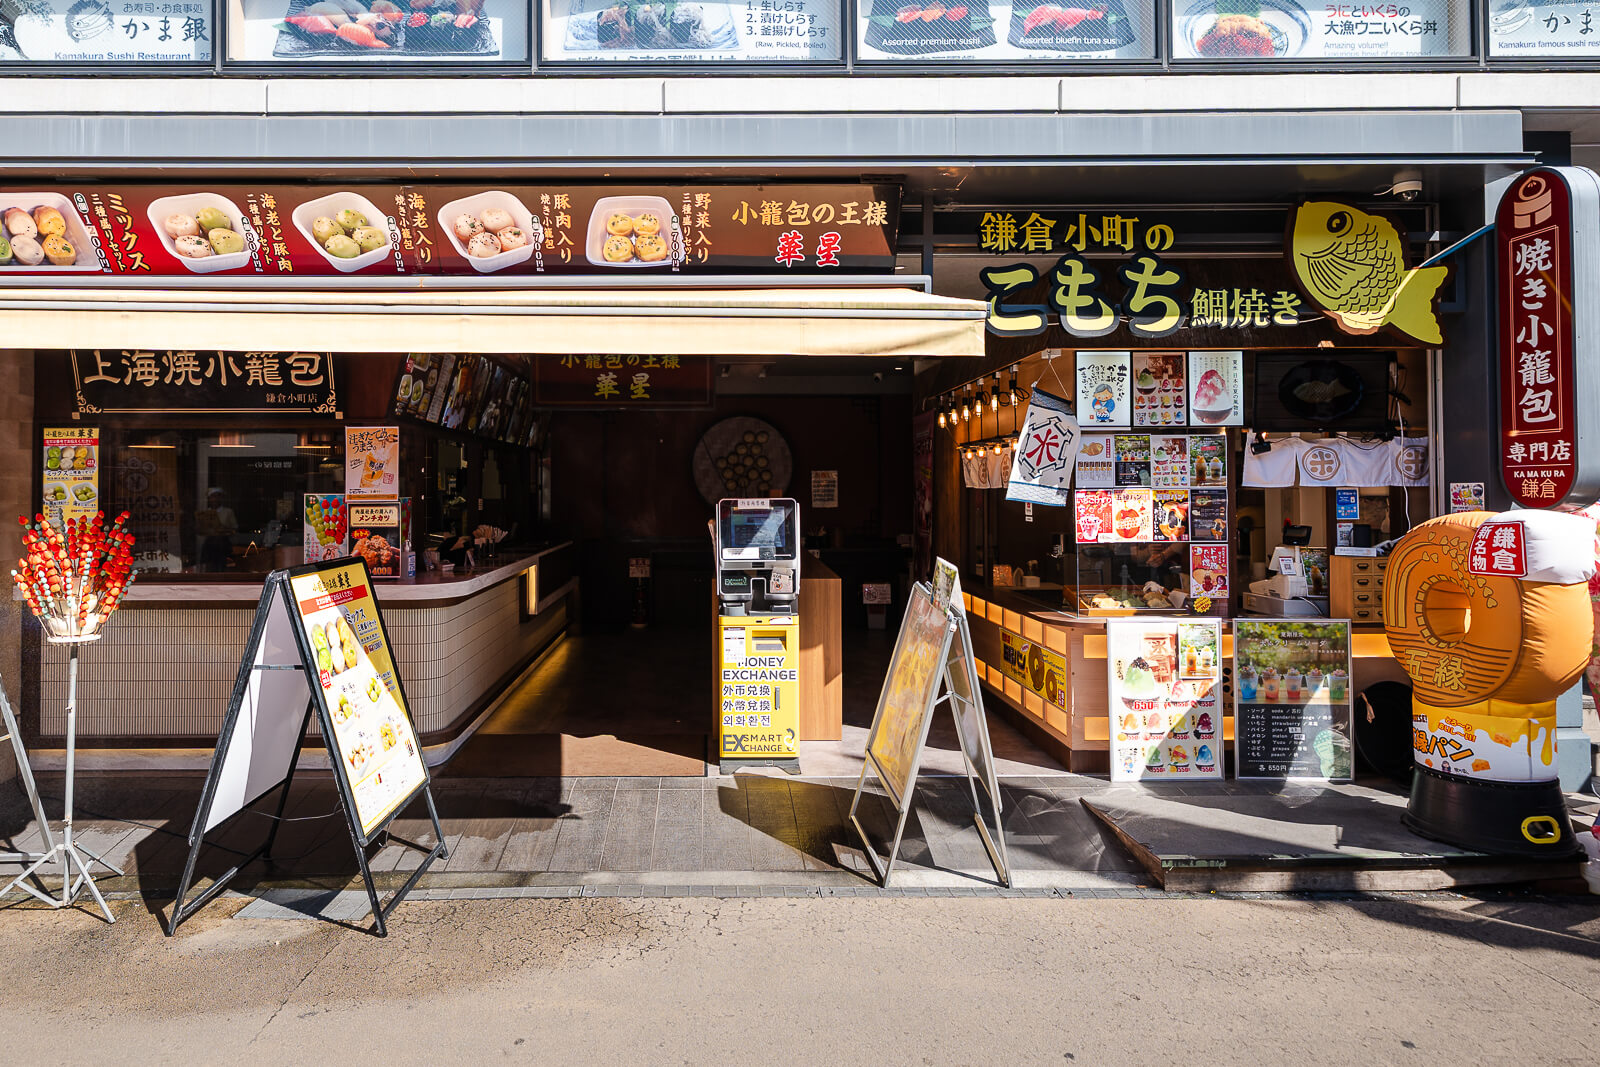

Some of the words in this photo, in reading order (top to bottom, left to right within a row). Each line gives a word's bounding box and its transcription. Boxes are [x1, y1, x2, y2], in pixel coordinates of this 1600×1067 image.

[123, 3, 203, 14] お寿司・お食事処
[746, 13, 757, 23] 2.
[760, 13, 818, 24] 漬けしらす
[761, 0, 804, 12] 生しらす
[1325, 4, 1410, 18] うにといくらの
[122, 16, 210, 42] かま銀
[746, 26, 757, 36] 3.
[760, 25, 829, 38] 釜揚げしらす
[1324, 20, 1437, 35] 大漁ウニいくら丼
[1542, 9, 1594, 35] かま
[776, 41, 801, 49] Pickled,
[882, 38, 917, 46] Assorted
[920, 38, 957, 47] premium
[959, 37, 981, 45] sushi
[1019, 37, 1054, 45] Assorted
[1056, 37, 1082, 45] bluefin
[1324, 42, 1355, 50] Amazing
[1498, 41, 1536, 49] Kamakura
[1538, 40, 1566, 48] famous
[54, 52, 104, 60] Kamakura
[107, 52, 135, 60] Sushi
[138, 52, 191, 60] Restaurant
[394, 194, 415, 250] 焼き小籠包
[540, 194, 555, 249] 焼き小籠包
[732, 200, 889, 226] 小籠包の王様
[90, 193, 127, 272] 三種盛りセット
[107, 193, 151, 271] ミックス
[247, 193, 272, 265] 二種盛りセット
[259, 193, 293, 272] 海老と豚肉
[407, 192, 433, 263] 海老入り
[553, 193, 574, 264] 豚肉入り
[682, 192, 692, 264] 三種盛りセット
[694, 193, 712, 263] 野菜入り
[980, 212, 1175, 251] 鎌倉小町の
[775, 230, 841, 267] 華星
[983, 255, 1183, 333] こもち
[1190, 288, 1303, 328] 鯛焼き
[1515, 238, 1556, 424] 焼き小籠包
[84, 351, 324, 387] 上海焼小籠包
[266, 392, 318, 403] 鎌倉小町店
[594, 372, 651, 400] 華星
[1506, 440, 1572, 463] 専門店
[1522, 478, 1557, 498] 鎌倉
[1473, 525, 1494, 571] 新名物
[1491, 527, 1517, 571] 鎌倉
[345, 609, 367, 624] ミックス
[723, 670, 796, 680] EXCHANGE
[1405, 649, 1467, 690] 五縁
[723, 715, 770, 726] 외화환전
[744, 734, 782, 742] SMART
